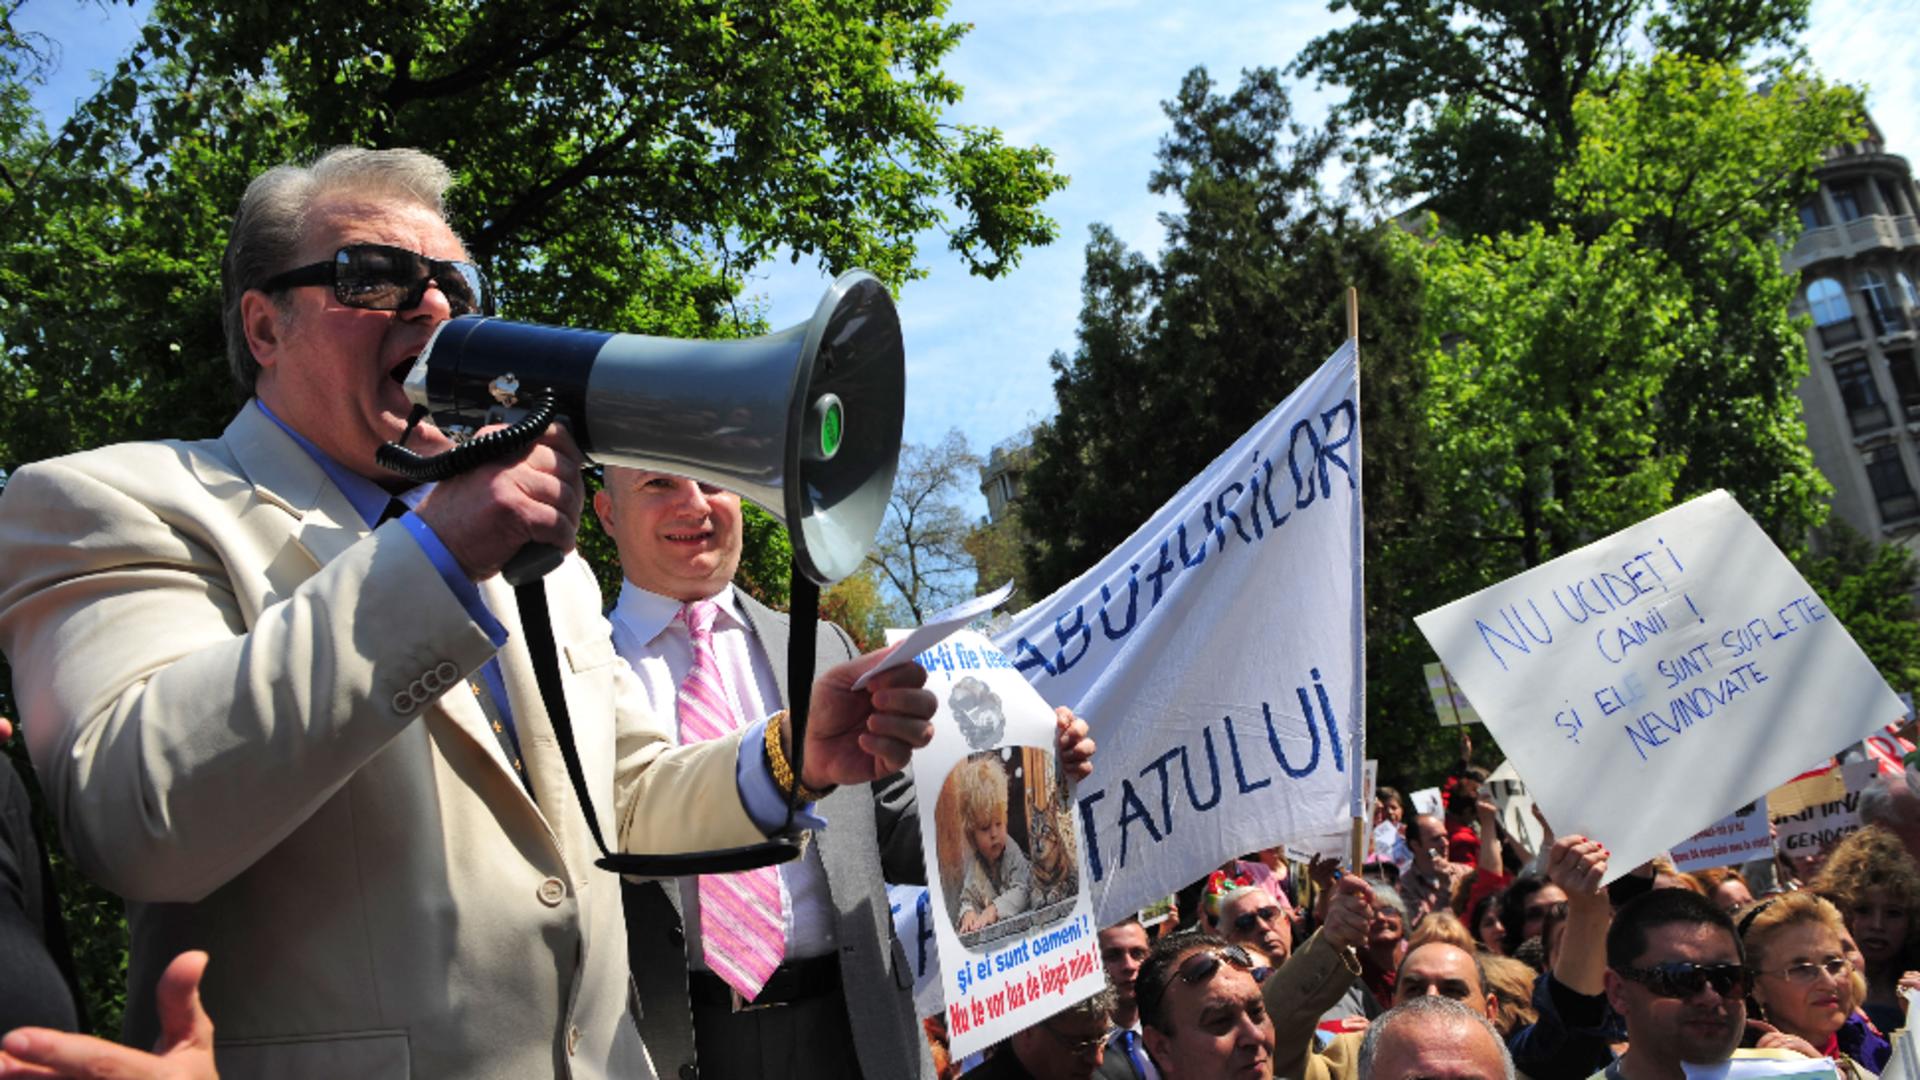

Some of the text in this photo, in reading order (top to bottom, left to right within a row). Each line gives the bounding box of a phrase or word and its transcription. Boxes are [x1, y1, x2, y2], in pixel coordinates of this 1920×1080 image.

[1475, 598, 1553, 671] NU
[1657, 642, 1713, 690] SUNT
[1721, 596, 1827, 658] SUFLETE
[1624, 661, 1769, 761] NEVINOVATE
[957, 961, 972, 996] și
[977, 952, 992, 981] ei
[995, 938, 1030, 973] sunt
[1032, 917, 1082, 957] oameni
[970, 996, 985, 1028] te
